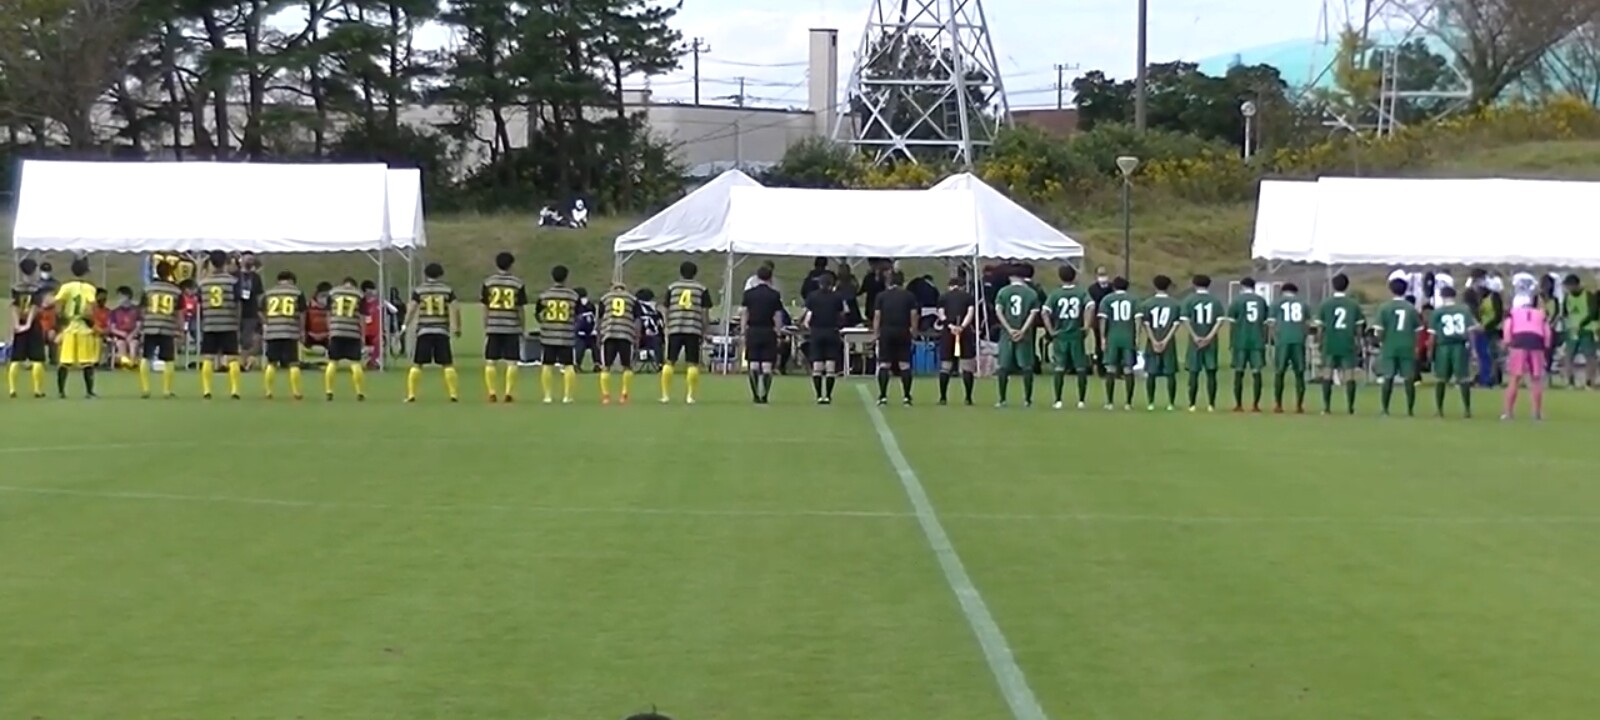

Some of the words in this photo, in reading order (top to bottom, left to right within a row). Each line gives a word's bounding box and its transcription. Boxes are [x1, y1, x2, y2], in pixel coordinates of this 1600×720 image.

[73, 294, 82, 316] 1
[152, 294, 173, 315] 19
[210, 286, 223, 307] 3
[267, 296, 295, 317] 26
[335, 296, 357, 317] 17
[424, 295, 445, 316] 11
[489, 287, 514, 310] 23
[678, 289, 692, 309] 4
[1010, 295, 1022, 316] 3
[546, 300, 569, 321] 33
[612, 298, 625, 317] 9
[1058, 297, 1080, 319] 23
[1110, 300, 1131, 321] 10
[1150, 306, 1170, 329] 14
[1194, 302, 1213, 324] 11
[1246, 301, 1258, 322] 5
[1281, 301, 1302, 322] 18
[1334, 307, 1347, 329] 2
[1395, 309, 1406, 331] 7
[1441, 313, 1465, 336] 33
